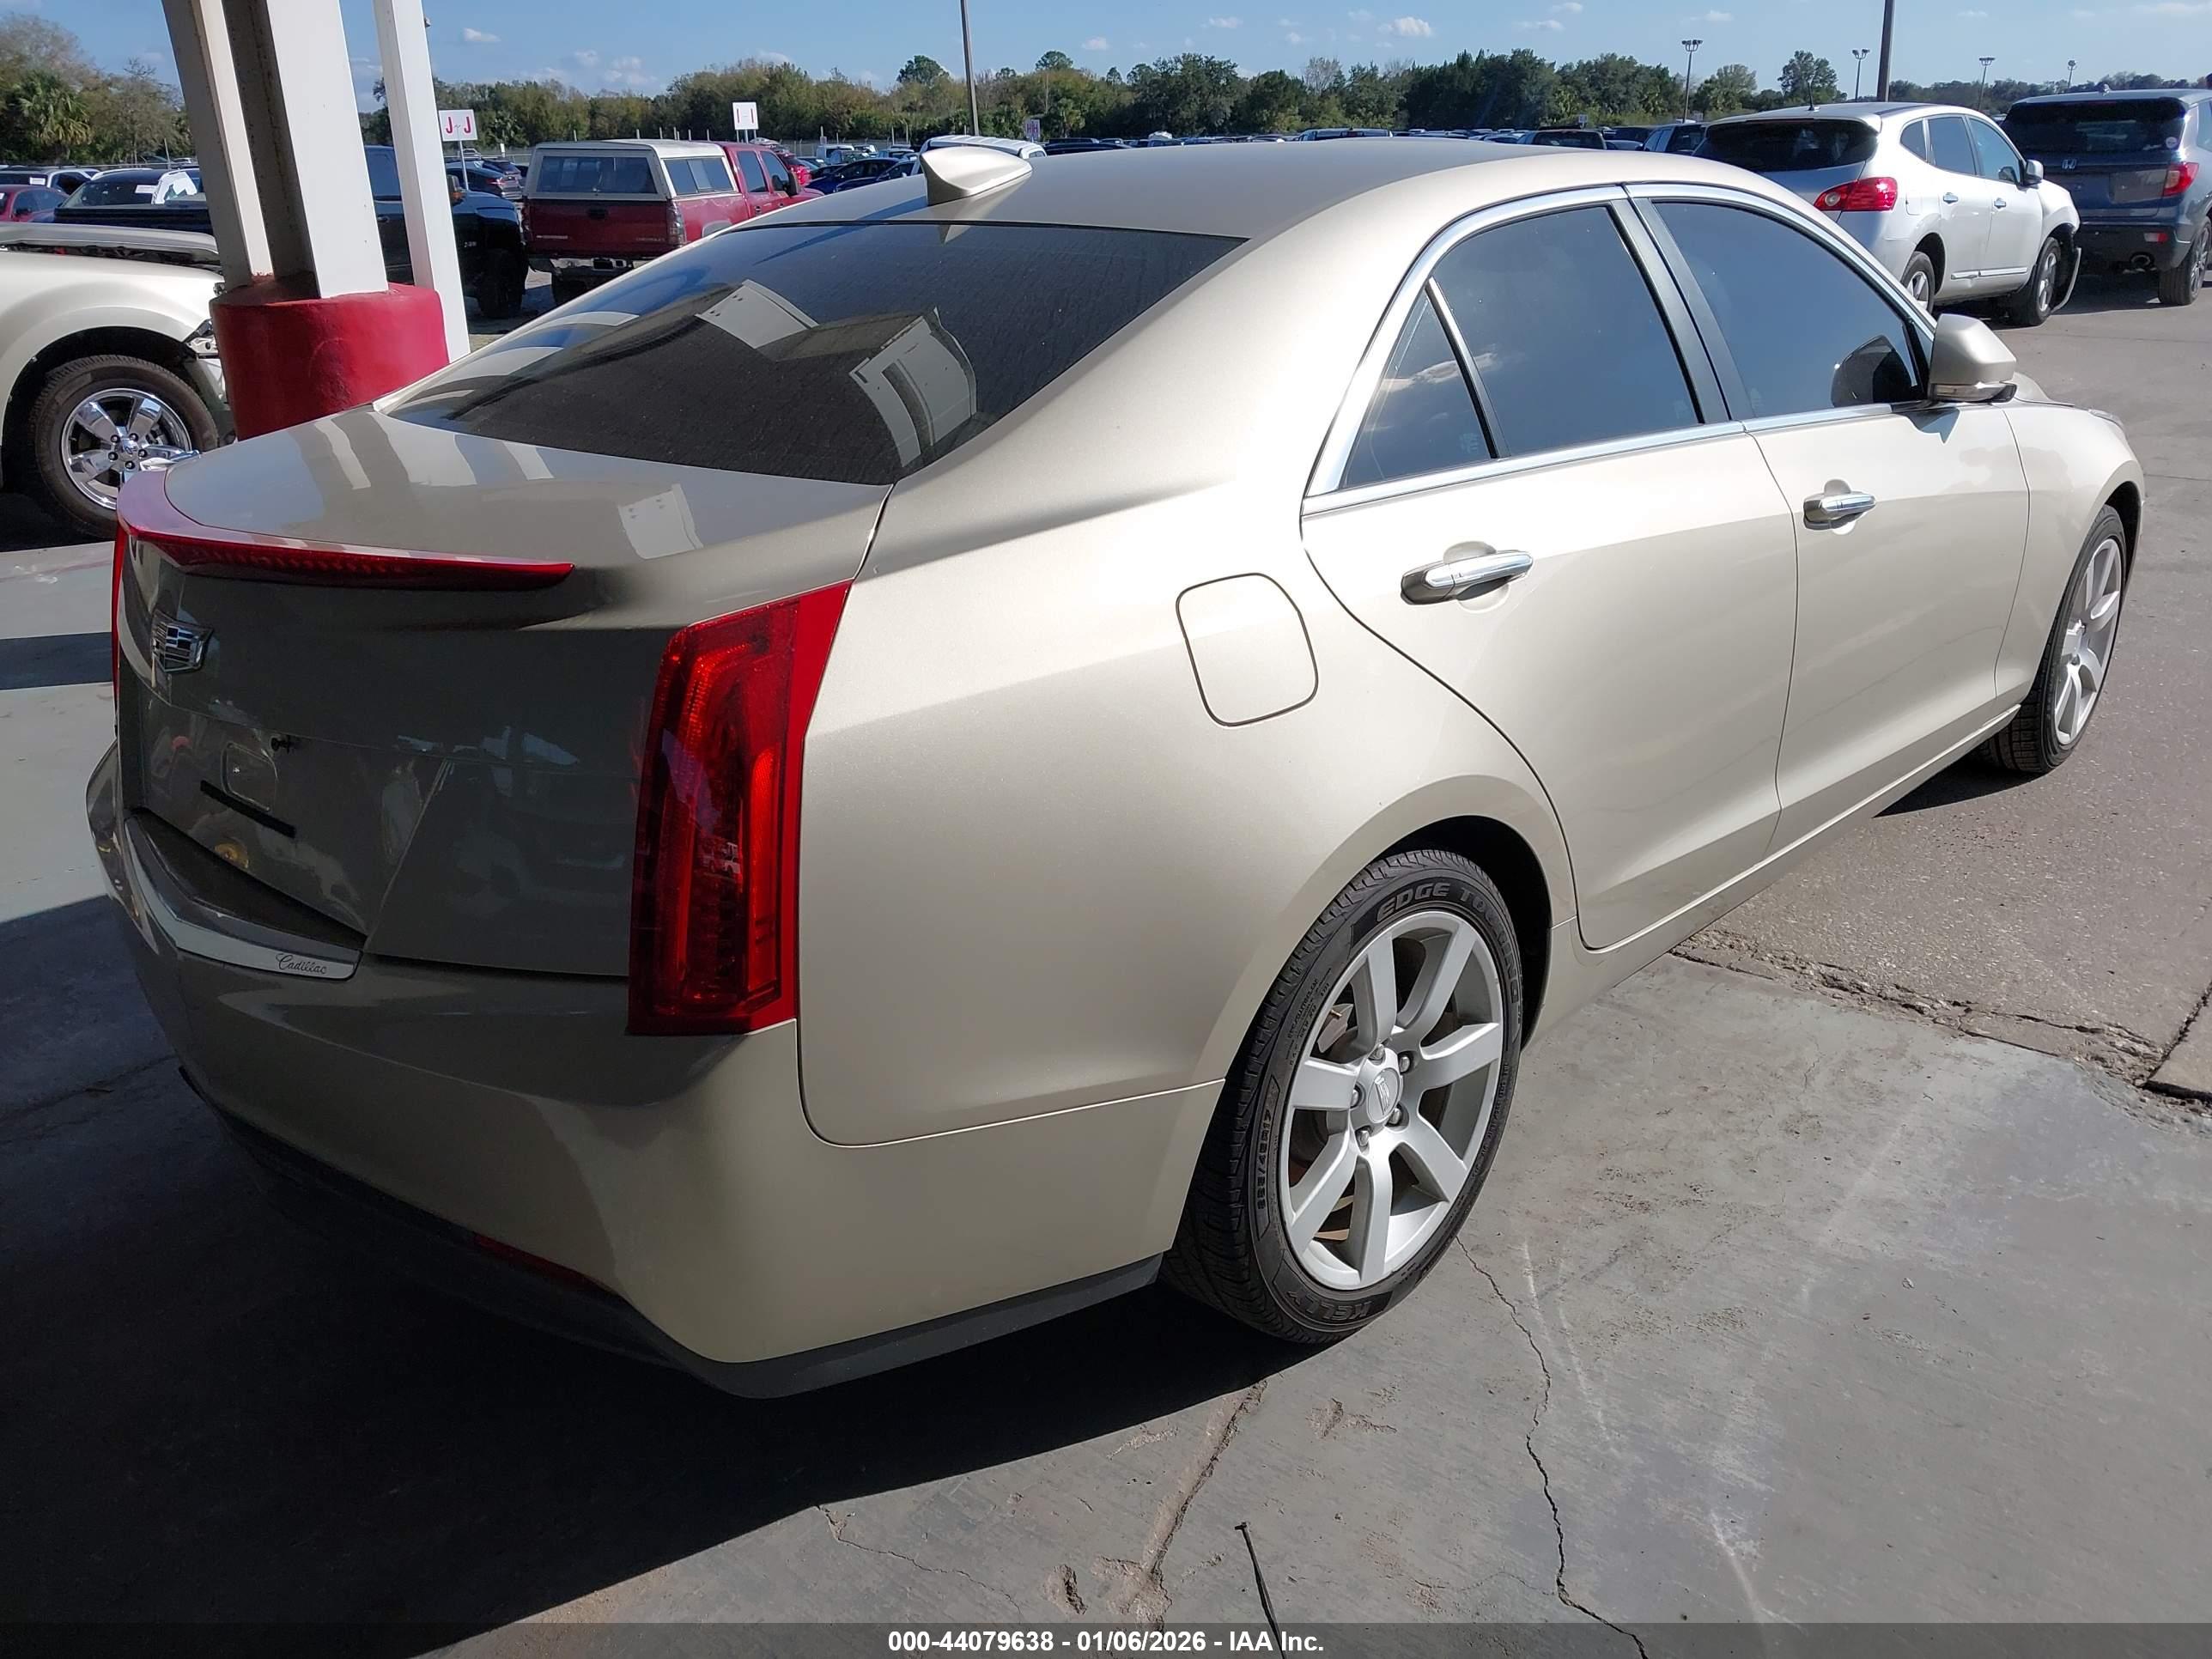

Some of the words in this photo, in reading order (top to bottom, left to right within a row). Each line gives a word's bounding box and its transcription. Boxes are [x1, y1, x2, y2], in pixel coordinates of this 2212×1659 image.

[1376, 882, 1451, 922] EDGE
[275, 953, 328, 975] Cadillac
[1285, 1290, 1374, 1321] KELLY
